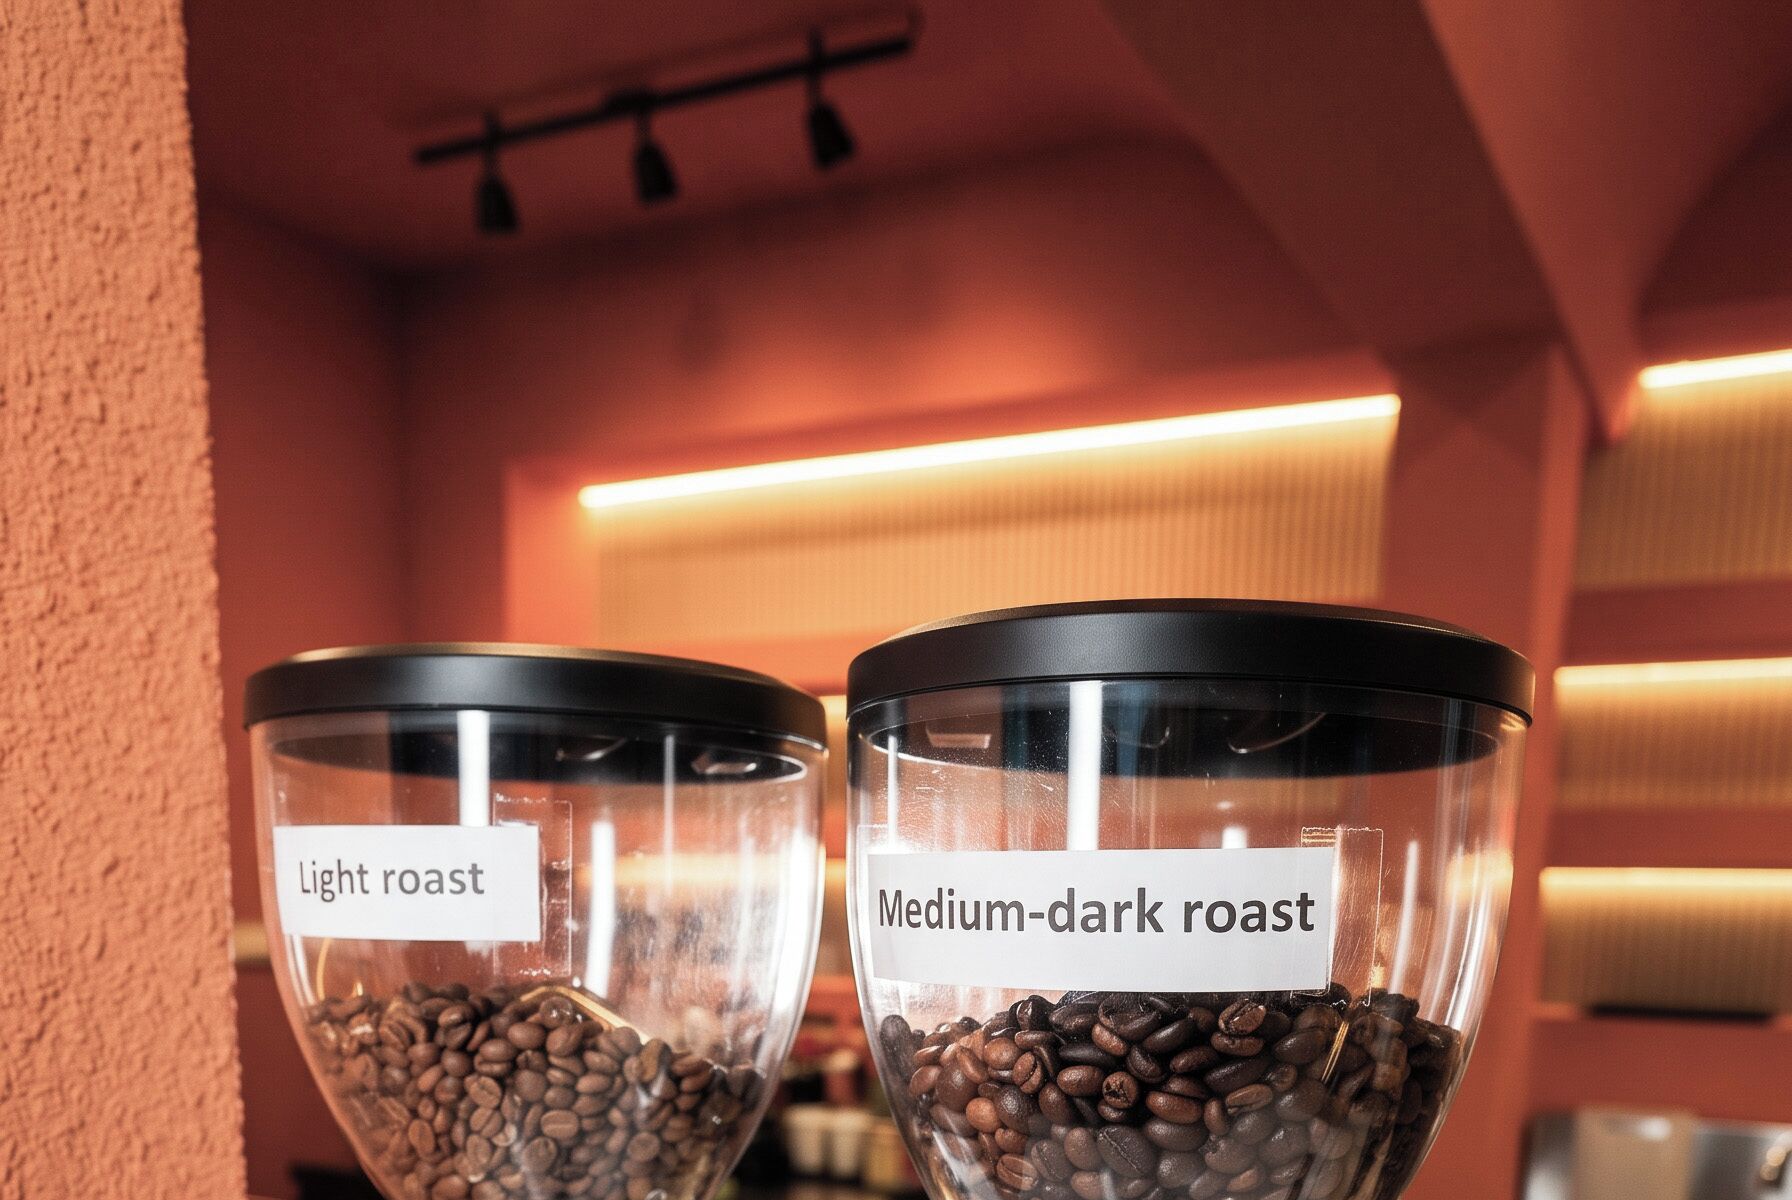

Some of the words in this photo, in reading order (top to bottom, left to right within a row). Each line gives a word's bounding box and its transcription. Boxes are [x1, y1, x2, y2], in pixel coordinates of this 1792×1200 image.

[299, 858, 370, 903] Light
[383, 863, 485, 895] roast
[878, 887, 1165, 934] Medium-dark
[1183, 892, 1315, 934] roast
